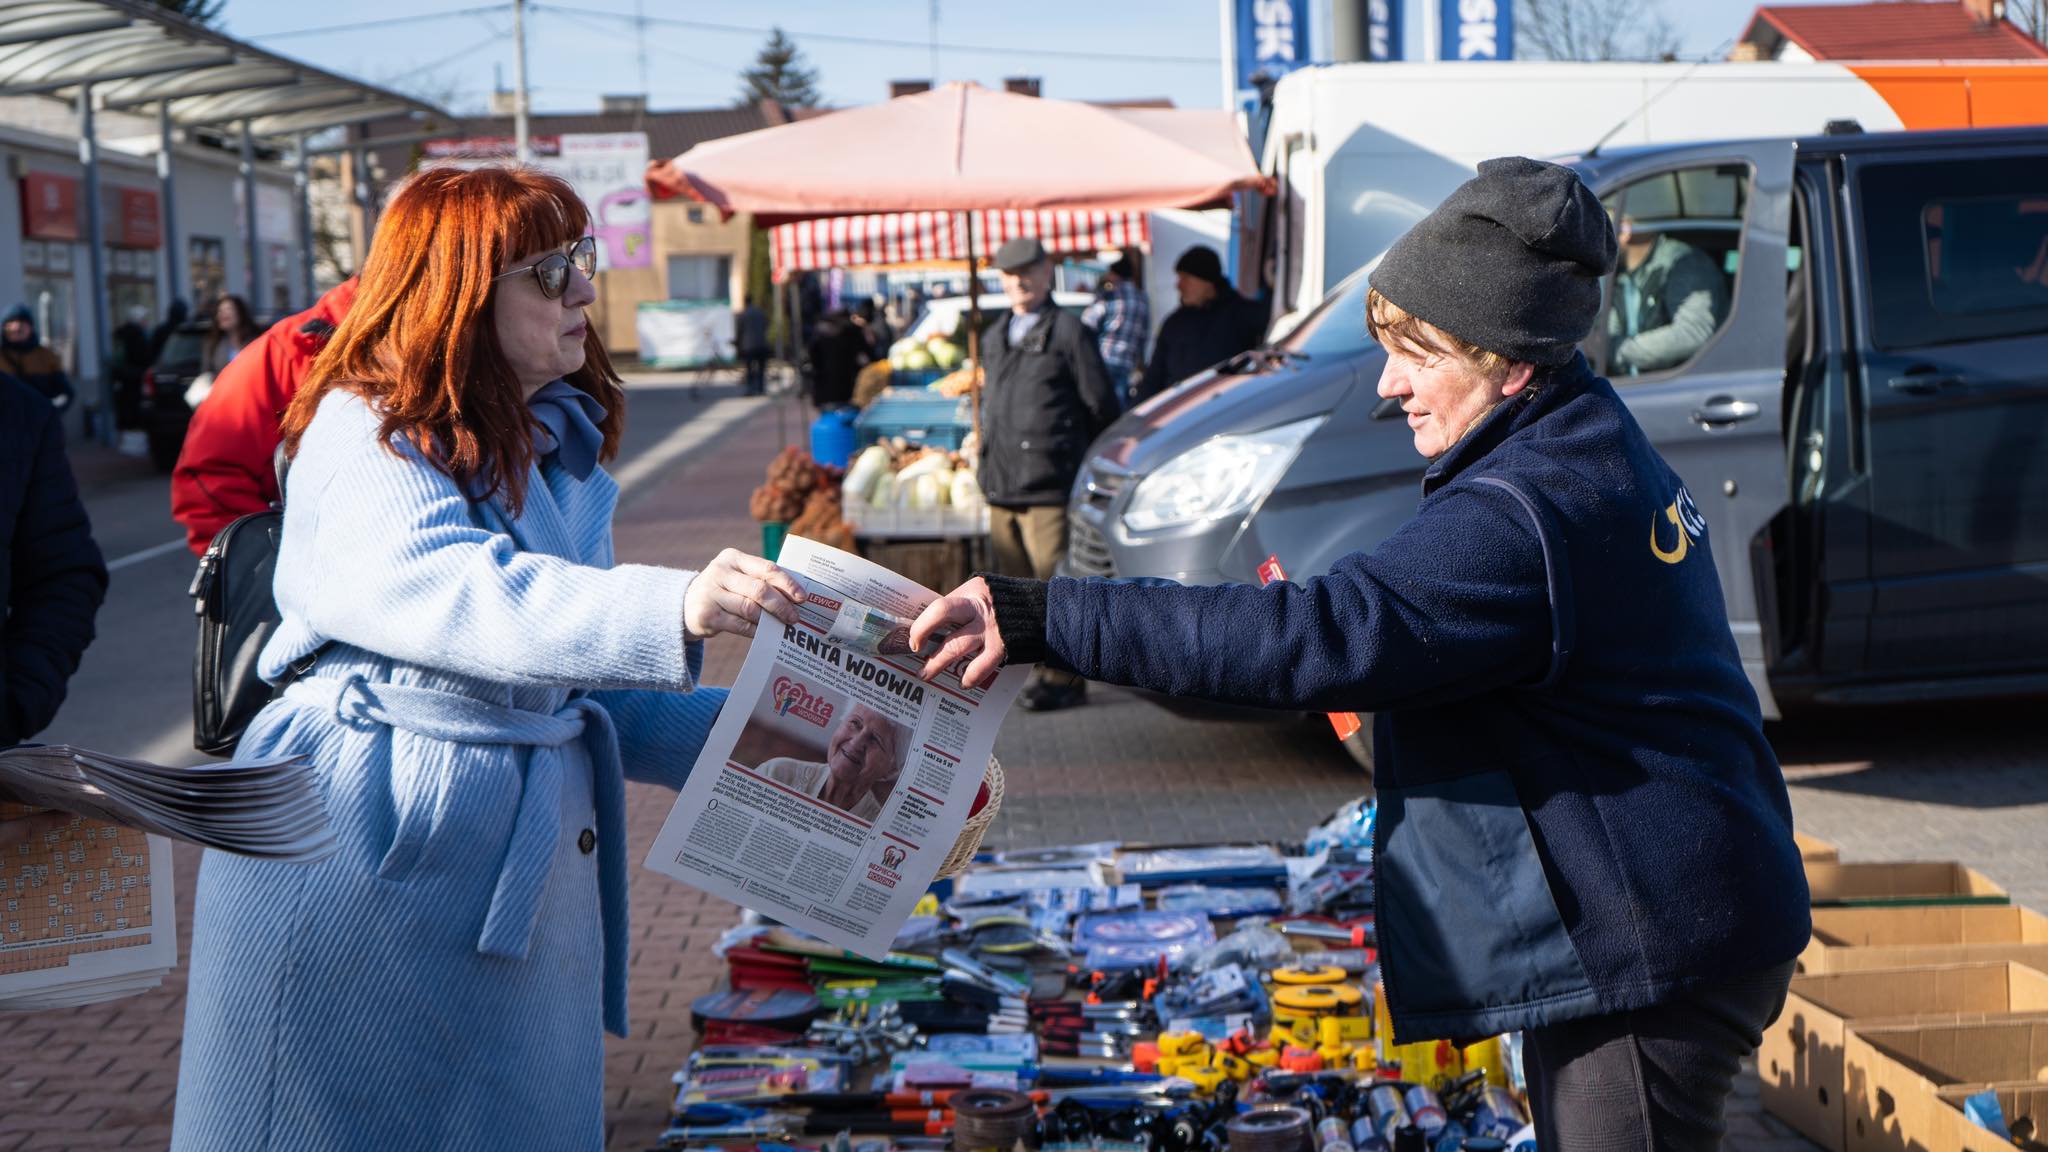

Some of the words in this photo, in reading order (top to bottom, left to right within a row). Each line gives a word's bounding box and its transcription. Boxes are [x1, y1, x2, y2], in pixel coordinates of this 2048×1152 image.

[807, 593, 840, 610] LEWICA
[779, 623, 846, 667] RENTA
[840, 652, 929, 706] WDOWIA
[775, 680, 838, 718] renta
[940, 696, 971, 716] Bezpieczny
[795, 707, 826, 726] WDOWIA
[937, 702, 956, 716] Senior
[922, 750, 937, 761] Leki
[934, 755, 943, 764] za
[945, 760, 954, 769] zł
[867, 861, 903, 881] BEZPIECZNA
[867, 871, 895, 888] RODZINA
